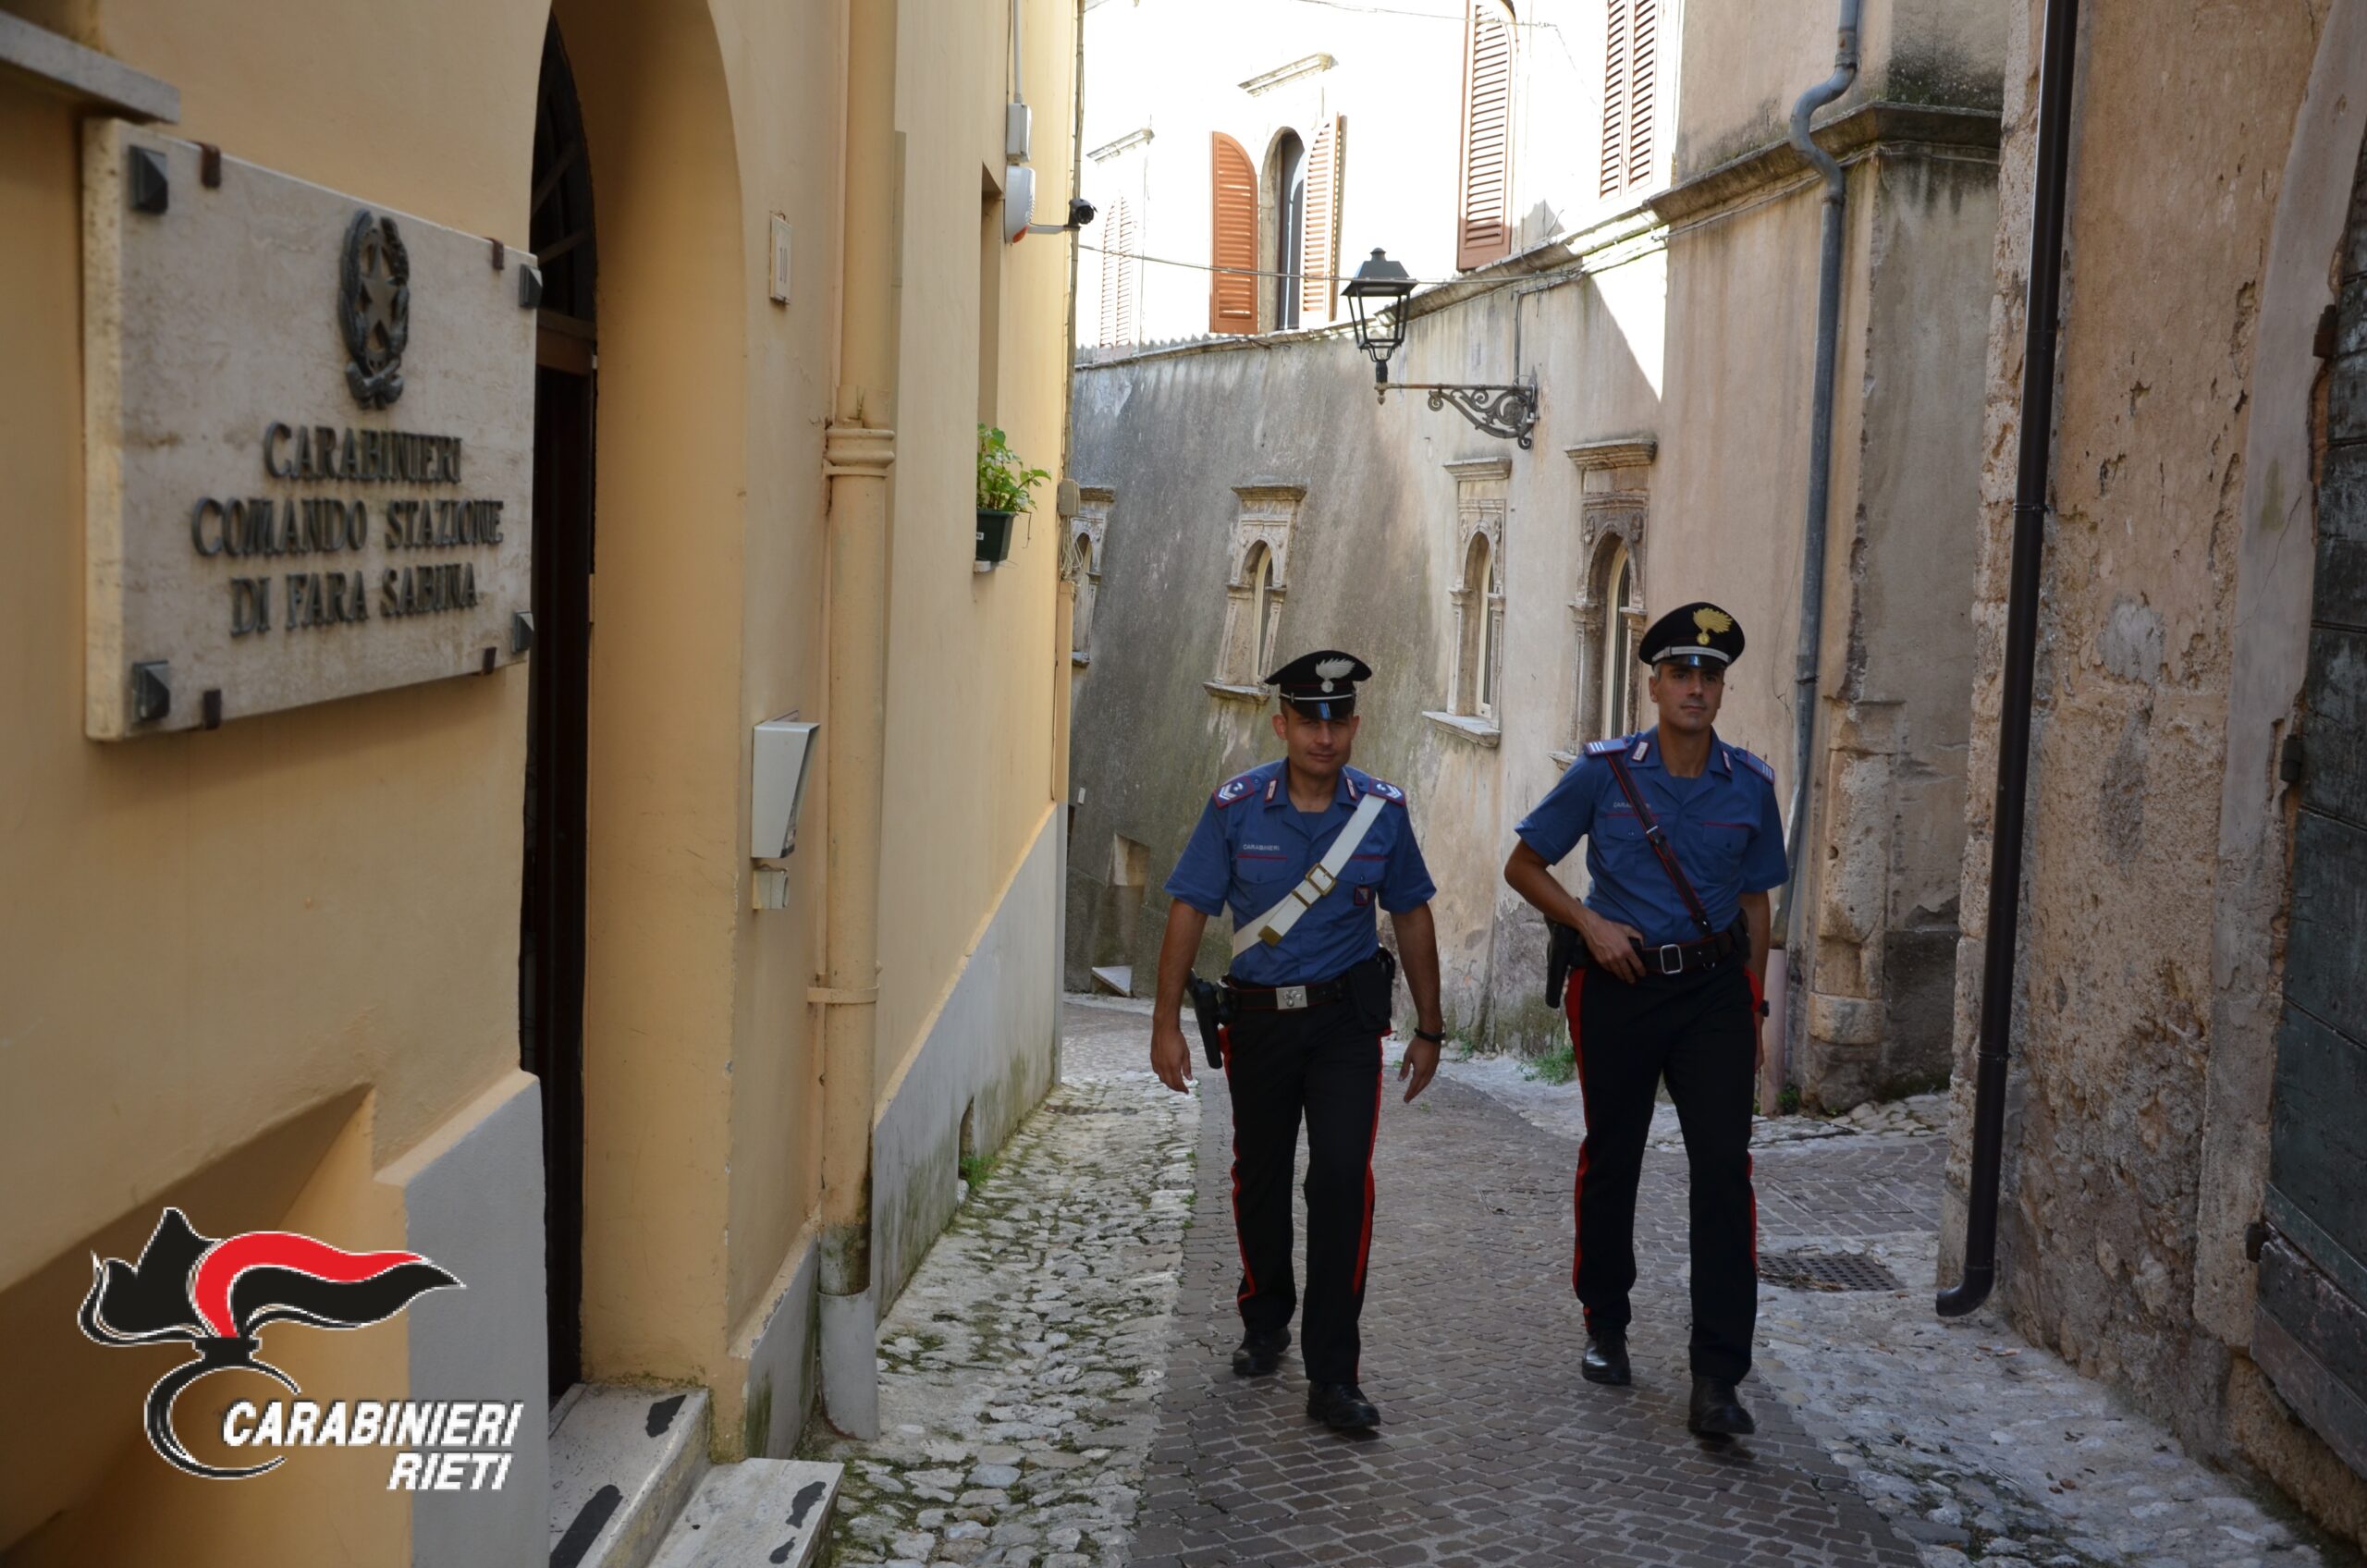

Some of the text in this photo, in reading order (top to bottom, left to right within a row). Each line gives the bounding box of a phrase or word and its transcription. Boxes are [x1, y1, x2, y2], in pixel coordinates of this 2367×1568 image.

[263, 420, 462, 484] CARABINIERI
[190, 496, 504, 557] COMANDO STAZIONE
[229, 562, 478, 636] DI FARA SABINA
